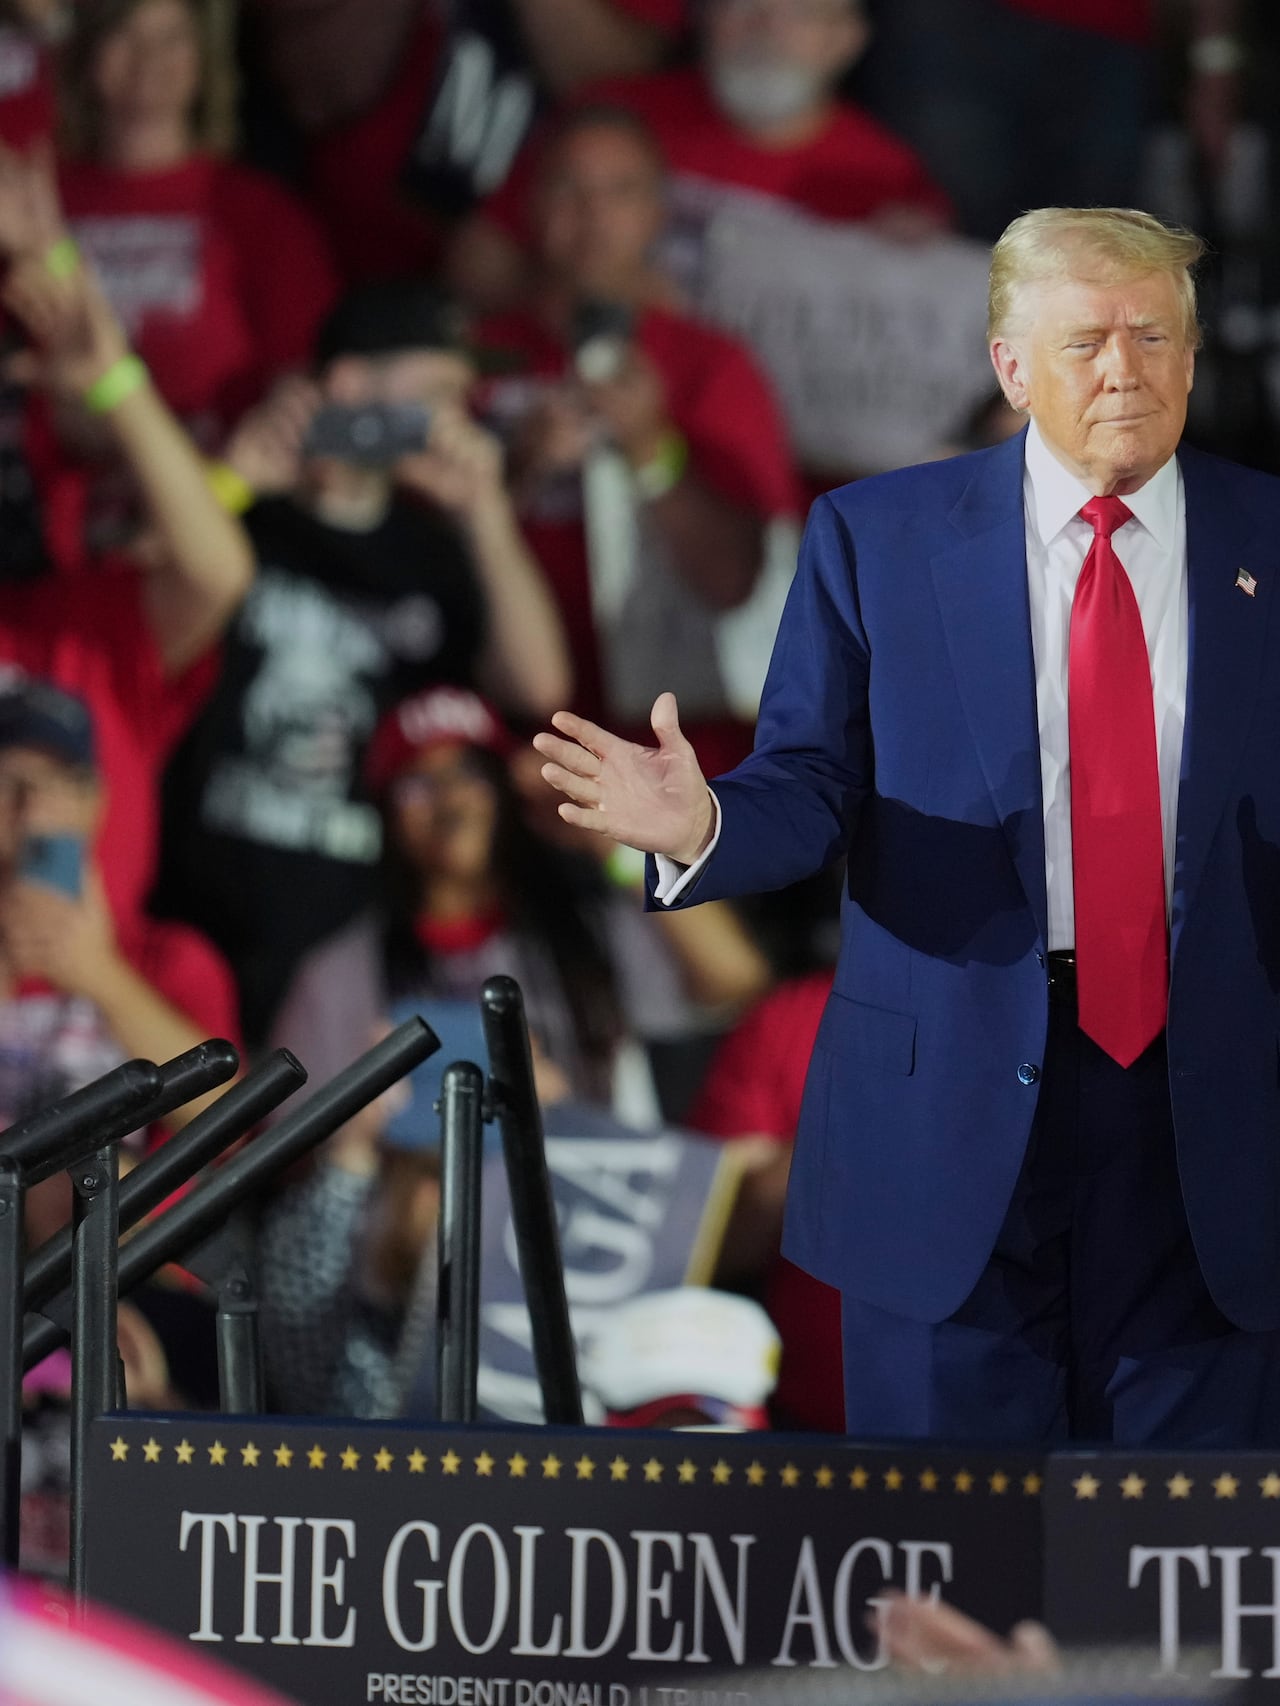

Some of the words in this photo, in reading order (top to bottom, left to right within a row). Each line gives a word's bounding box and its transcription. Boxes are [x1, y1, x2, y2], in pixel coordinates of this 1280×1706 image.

[179, 1510, 356, 1650] THE
[383, 1520, 756, 1666] GOLDEN
[367, 1672, 511, 1706] PRESIDENT
[515, 1679, 631, 1706] DONALD
